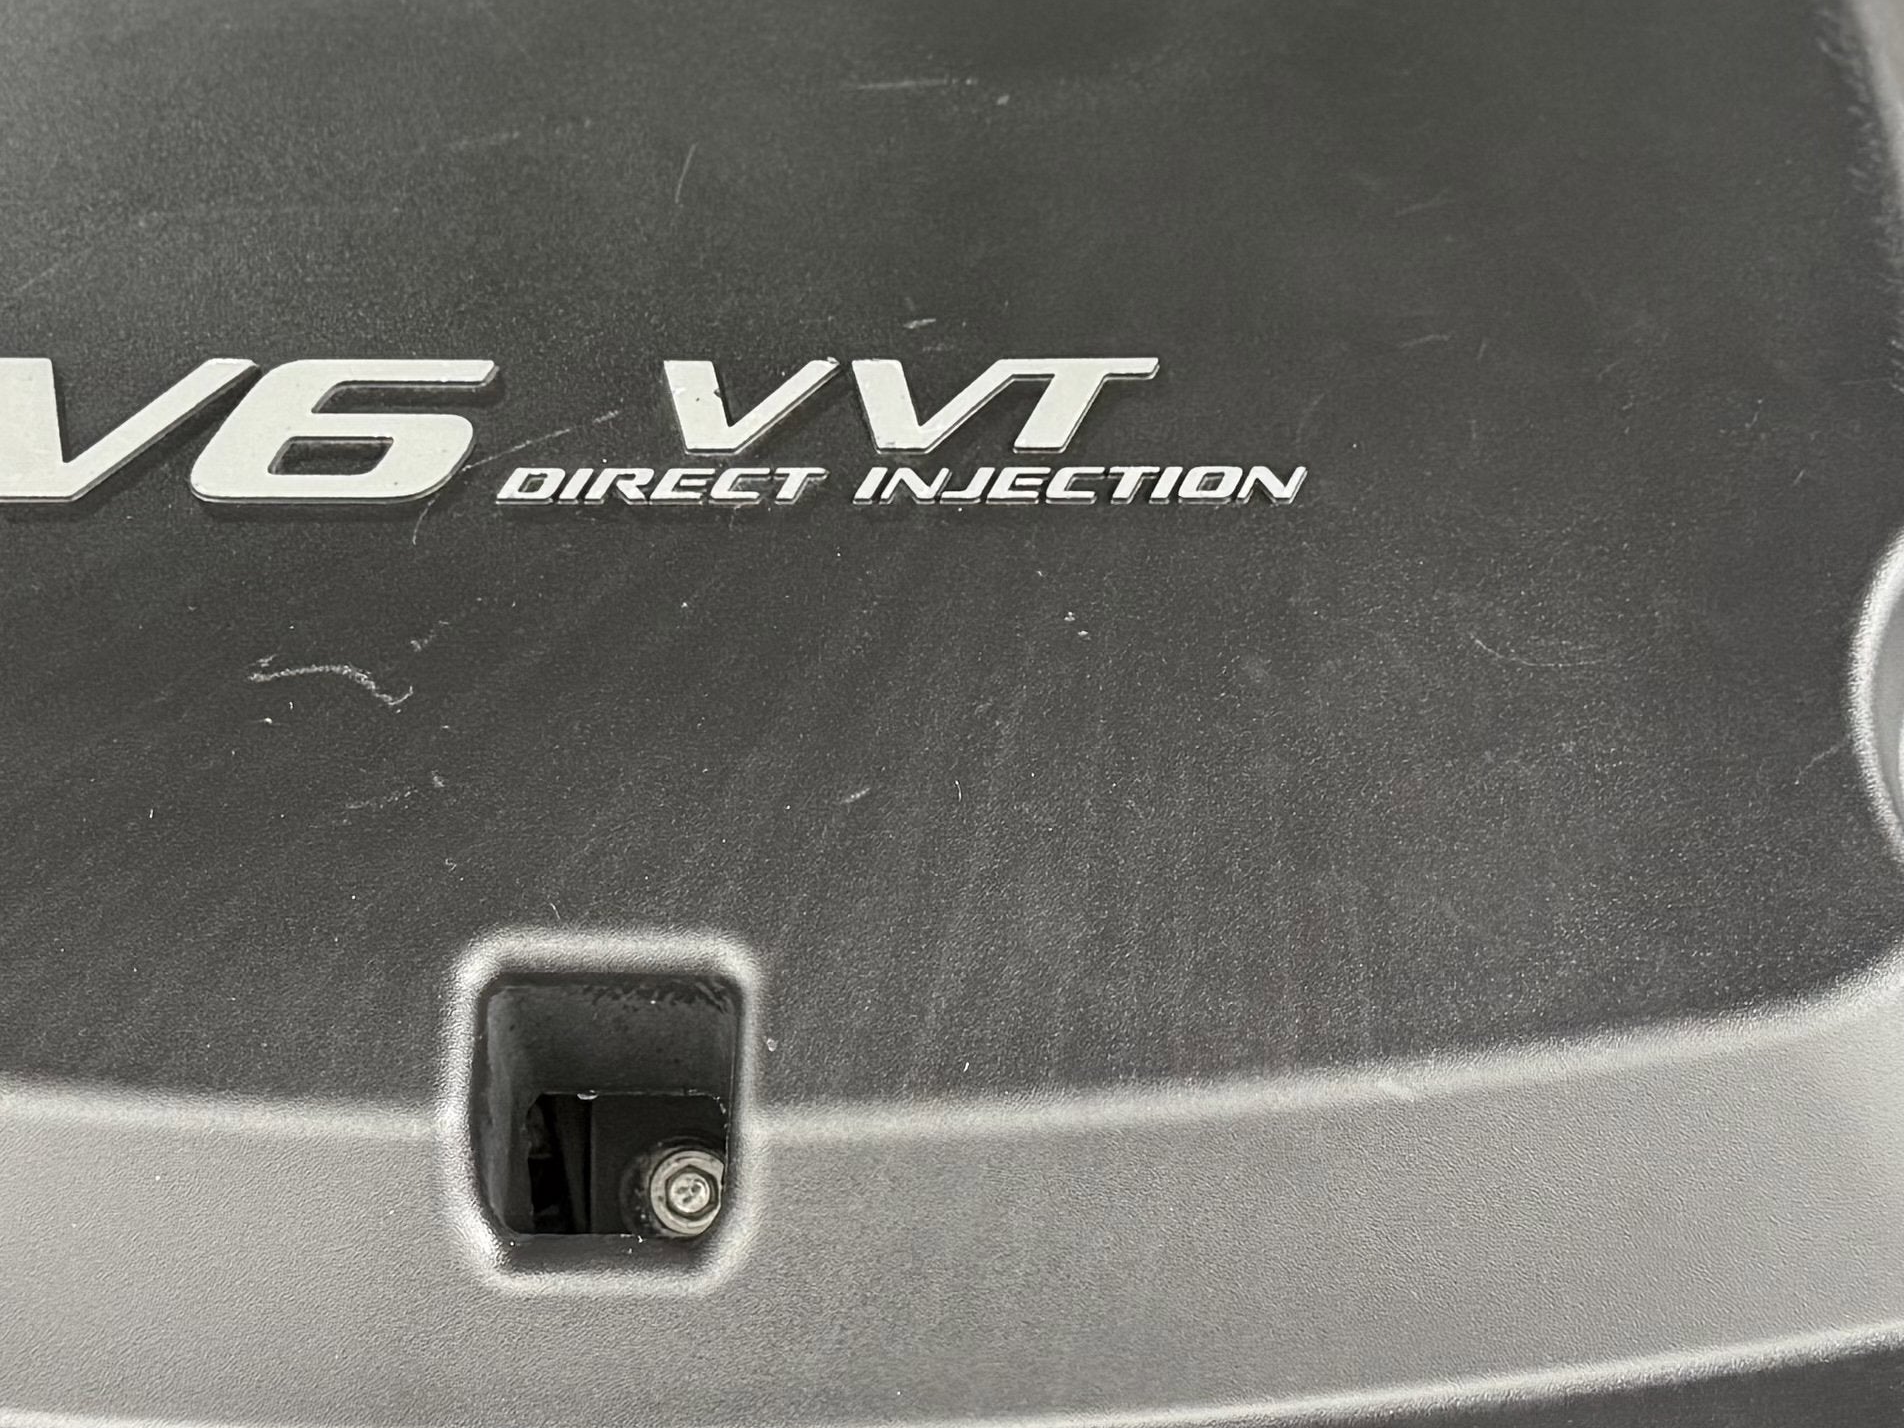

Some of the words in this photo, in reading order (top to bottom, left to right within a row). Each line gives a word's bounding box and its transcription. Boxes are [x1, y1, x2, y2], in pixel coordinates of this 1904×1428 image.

[662, 357, 1159, 455] VVT
[496, 465, 829, 505] DIRECT
[851, 465, 1307, 506] INJECTION
